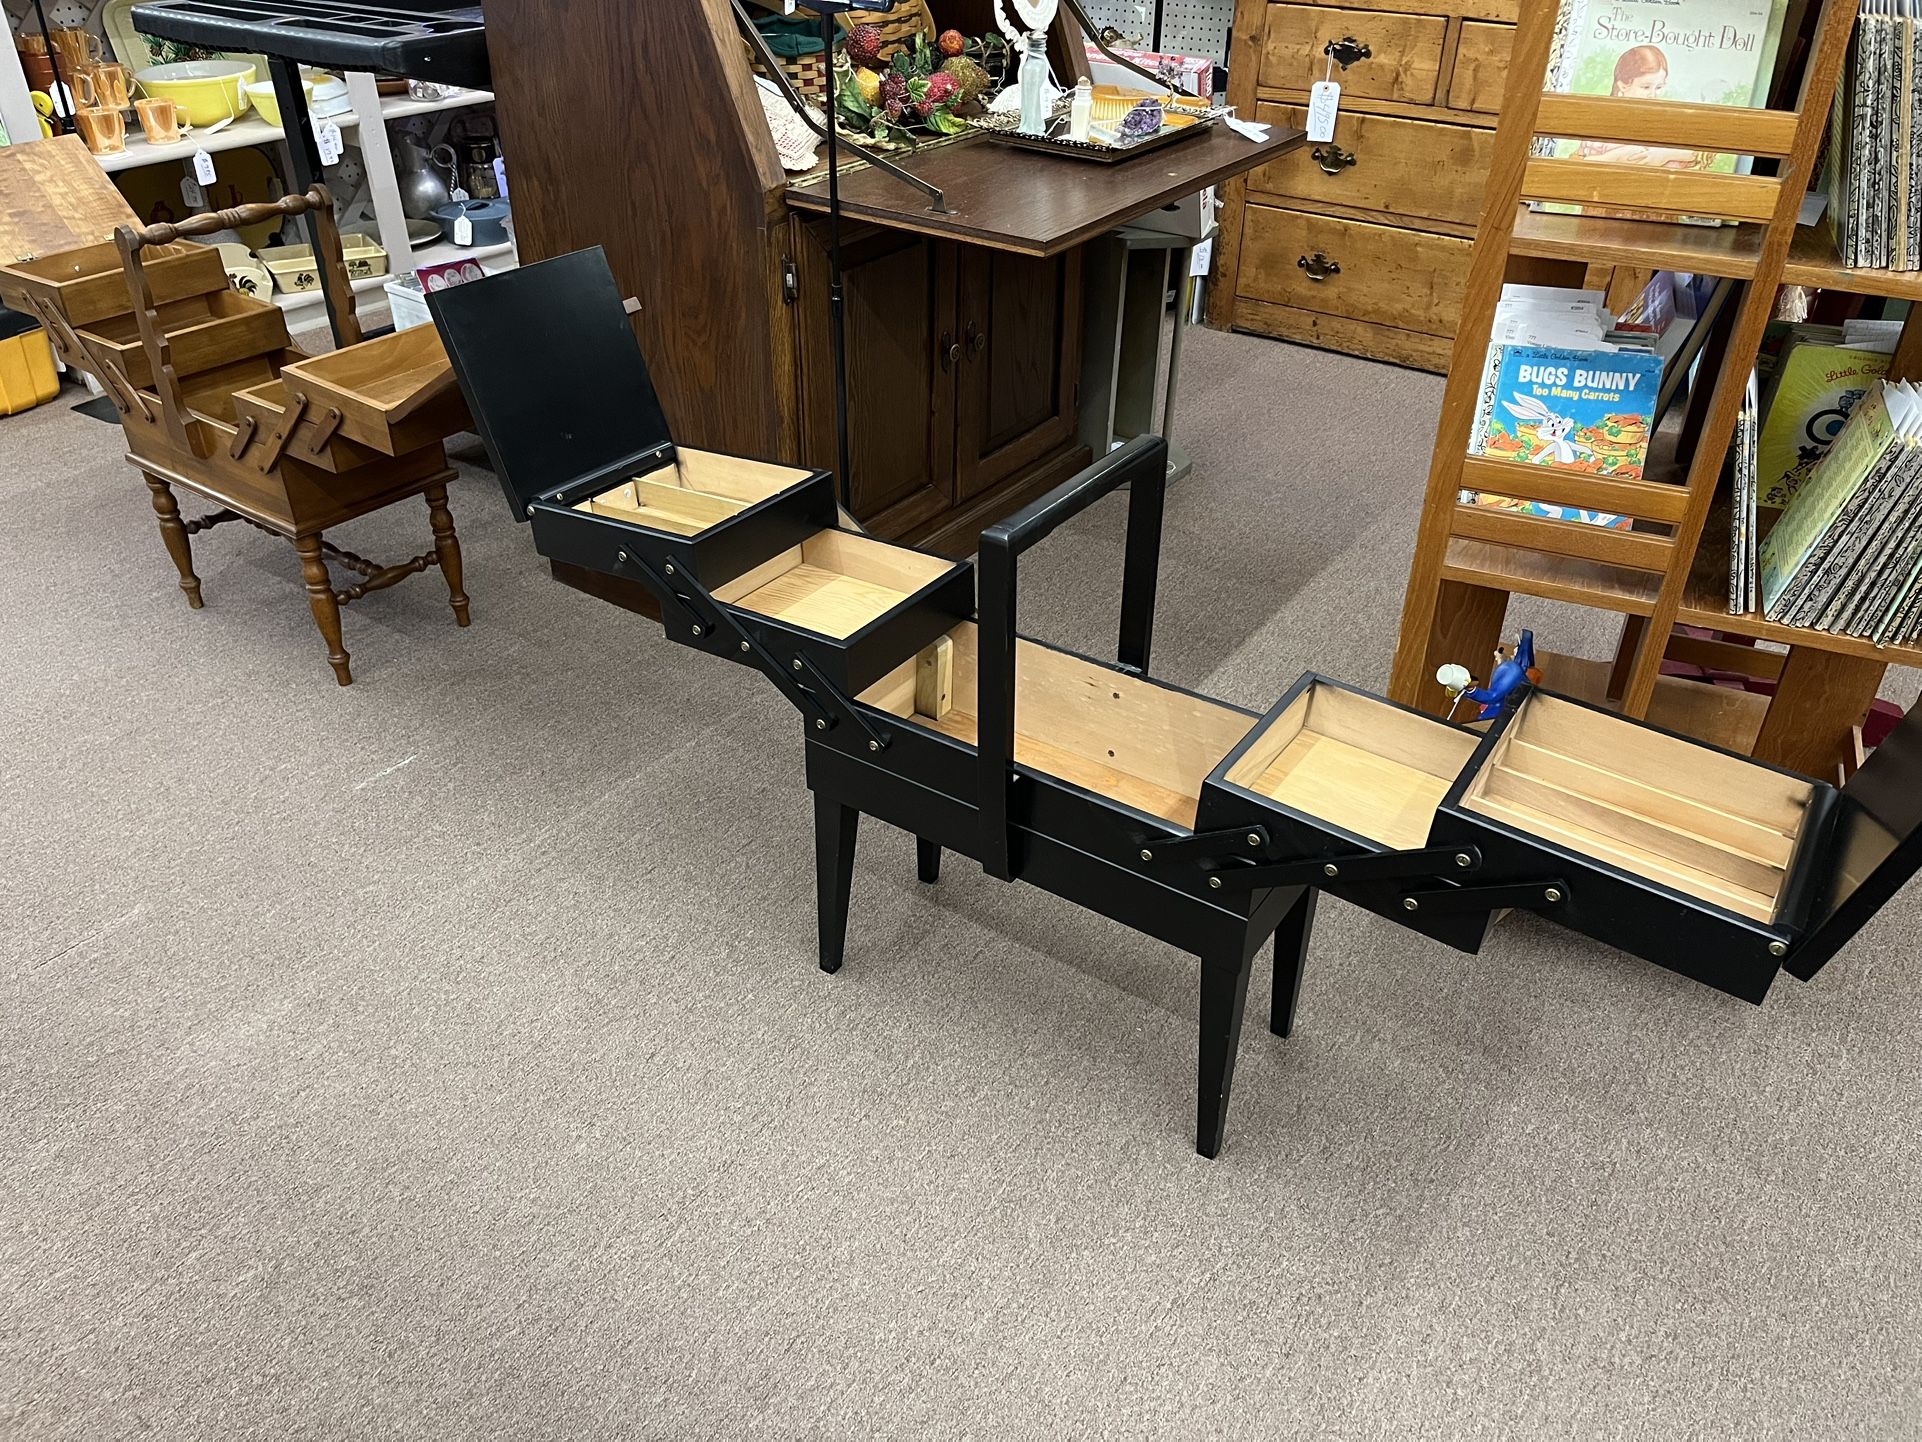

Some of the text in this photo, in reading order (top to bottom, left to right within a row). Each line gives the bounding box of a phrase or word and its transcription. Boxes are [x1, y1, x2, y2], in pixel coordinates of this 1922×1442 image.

[1612, 6, 1635, 22] The
[1593, 16, 1756, 52] Store-Bought Doll
[1518, 365, 1641, 391] BUGS BUNNY
[1825, 366, 1857, 383] Little
[1532, 385, 1620, 402] Too Many Carrots
